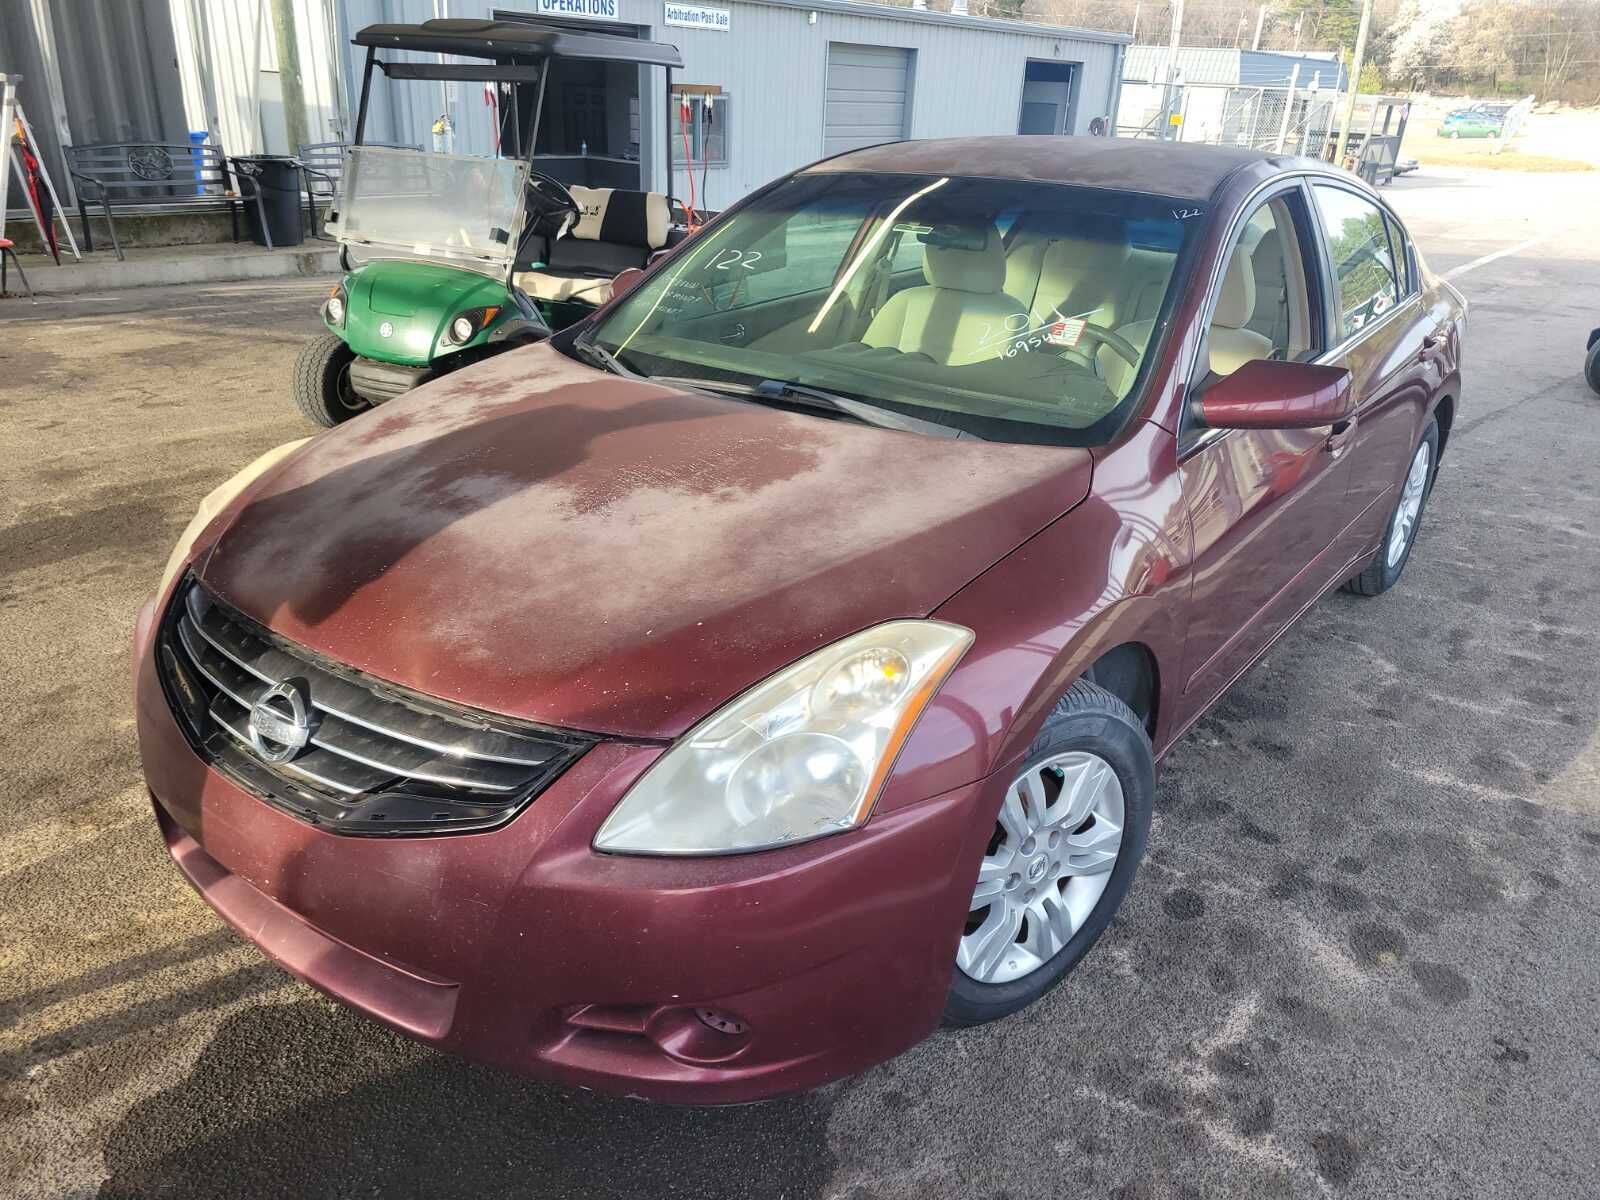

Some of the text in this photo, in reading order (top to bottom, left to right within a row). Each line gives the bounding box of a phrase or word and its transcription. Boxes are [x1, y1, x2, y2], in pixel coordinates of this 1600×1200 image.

[543, 0, 615, 16] OPERATIONS
[715, 13, 728, 25] Sale
[1172, 208, 1203, 220] 122
[704, 248, 762, 270] 122
